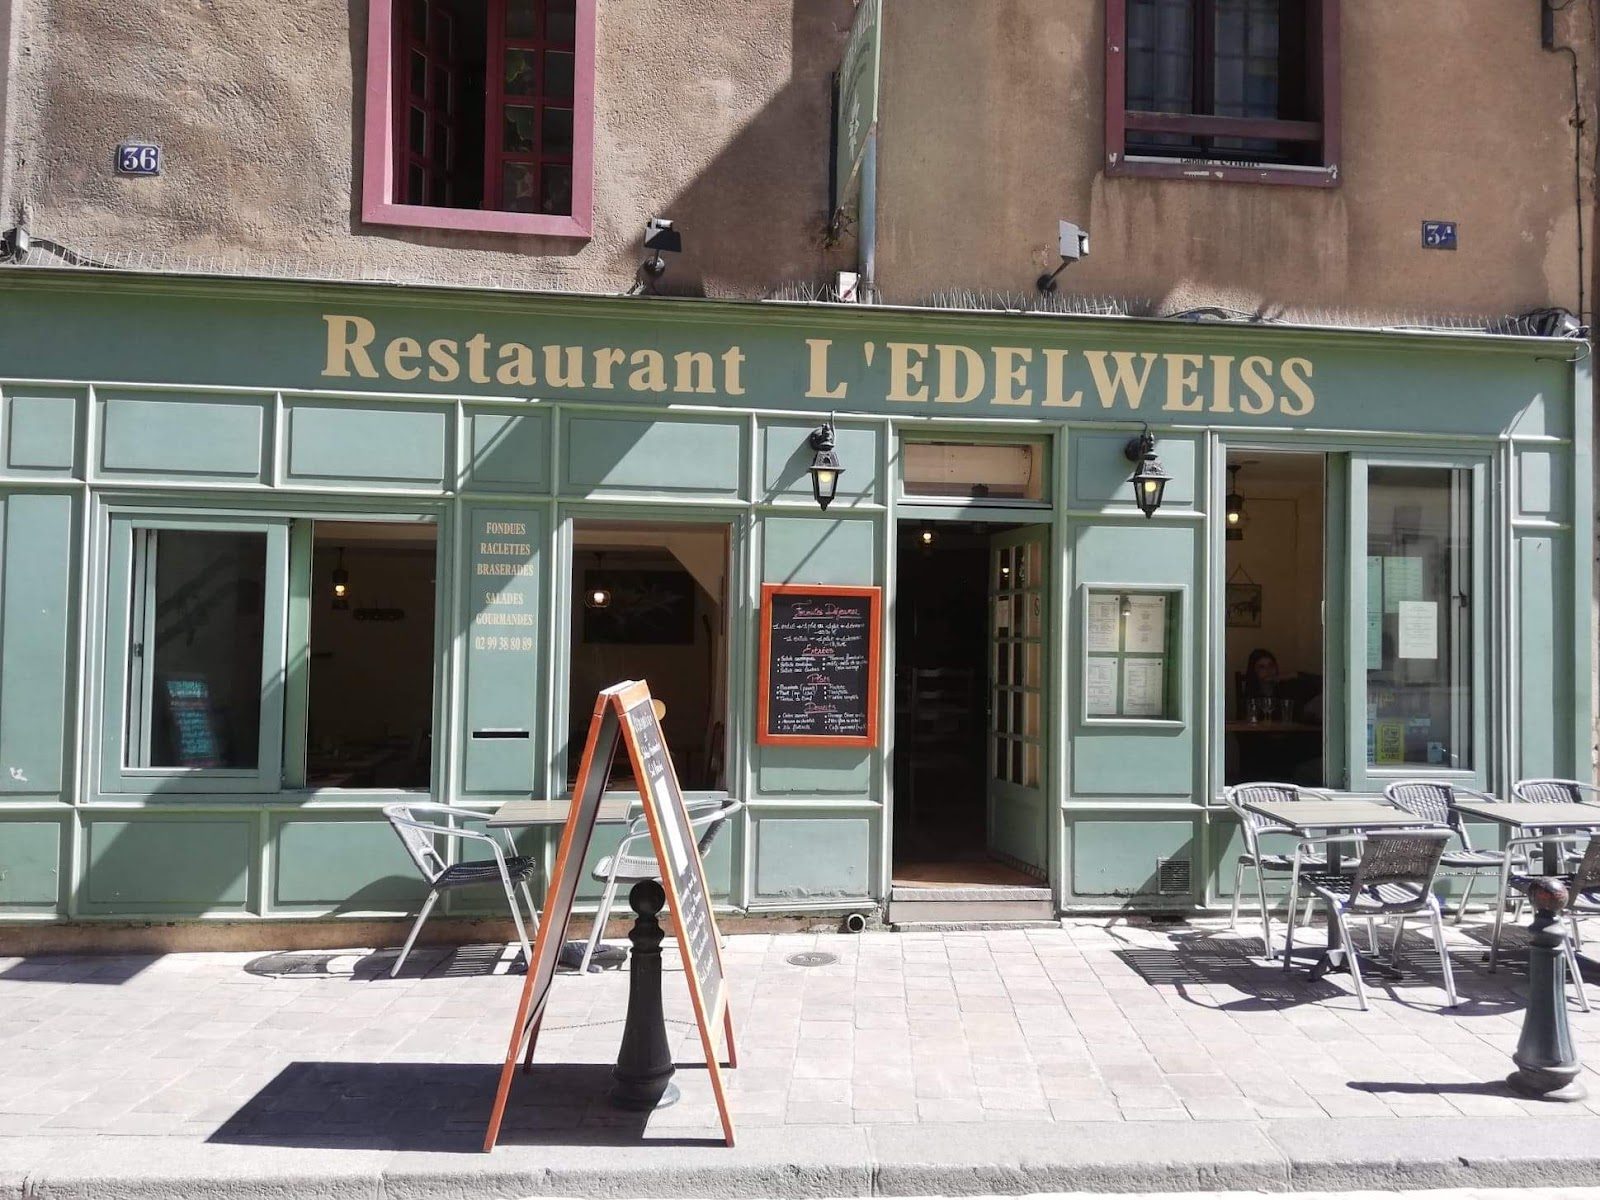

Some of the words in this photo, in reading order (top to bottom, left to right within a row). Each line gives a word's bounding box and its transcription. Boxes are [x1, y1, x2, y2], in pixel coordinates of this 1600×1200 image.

[123, 147, 156, 170] 36
[321, 314, 746, 395] Restaurant
[486, 522, 526, 535] FONDUES
[480, 542, 531, 555] RACLETTES
[477, 563, 534, 577] BRASERADES
[485, 592, 524, 605] SALADES
[475, 612, 534, 626] GOURMANDES
[475, 636, 485, 650] 02
[487, 636, 497, 650] 99
